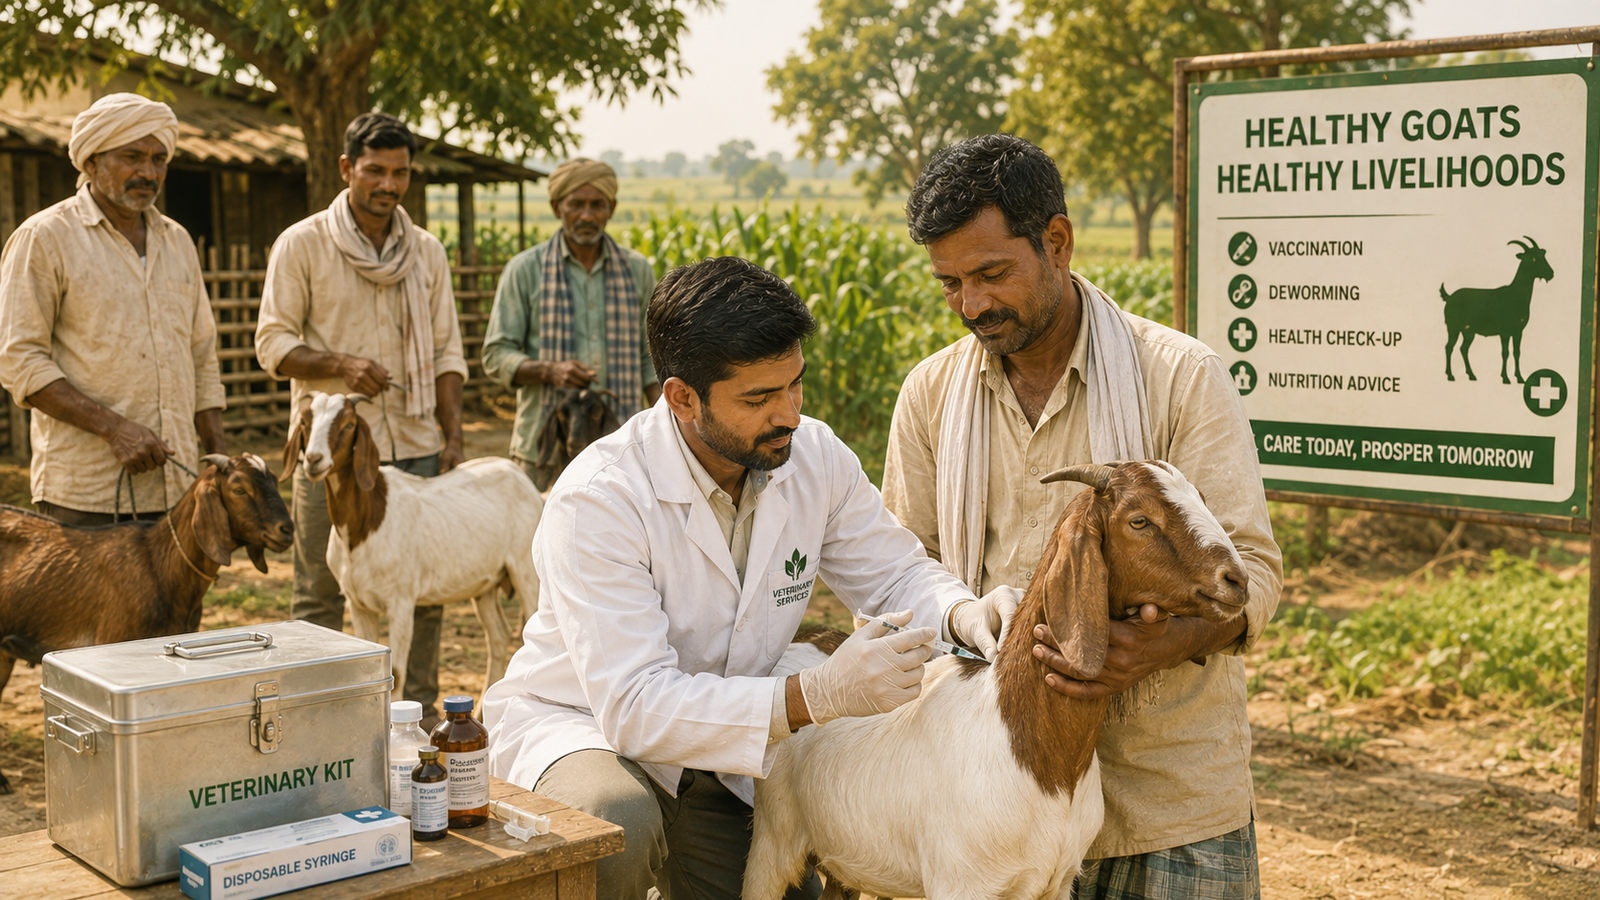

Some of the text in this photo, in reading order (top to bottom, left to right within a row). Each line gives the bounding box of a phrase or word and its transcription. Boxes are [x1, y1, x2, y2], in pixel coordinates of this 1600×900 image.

[1245, 104, 1521, 148] HEALTHY GOATS
[1217, 152, 1566, 194] HEALTHY LIVELIHOODS
[1269, 240, 1363, 256] VACCINATION
[1269, 285, 1360, 301] DEWORMING
[1269, 328, 1402, 347] HEALTH CHECK-UP
[1268, 372, 1400, 392] NUTRITION ADVICE
[1263, 434, 1302, 454] CARE
[1305, 437, 1357, 461] TODAY,
[1361, 442, 1434, 463] PROSPER
[1437, 445, 1534, 469] TOMORROW
[776, 590, 809, 607] SERVICES
[189, 758, 355, 809] VETERINARY KIT
[223, 860, 301, 889] DISPOSABLE
[304, 848, 356, 871] SYRINGE
